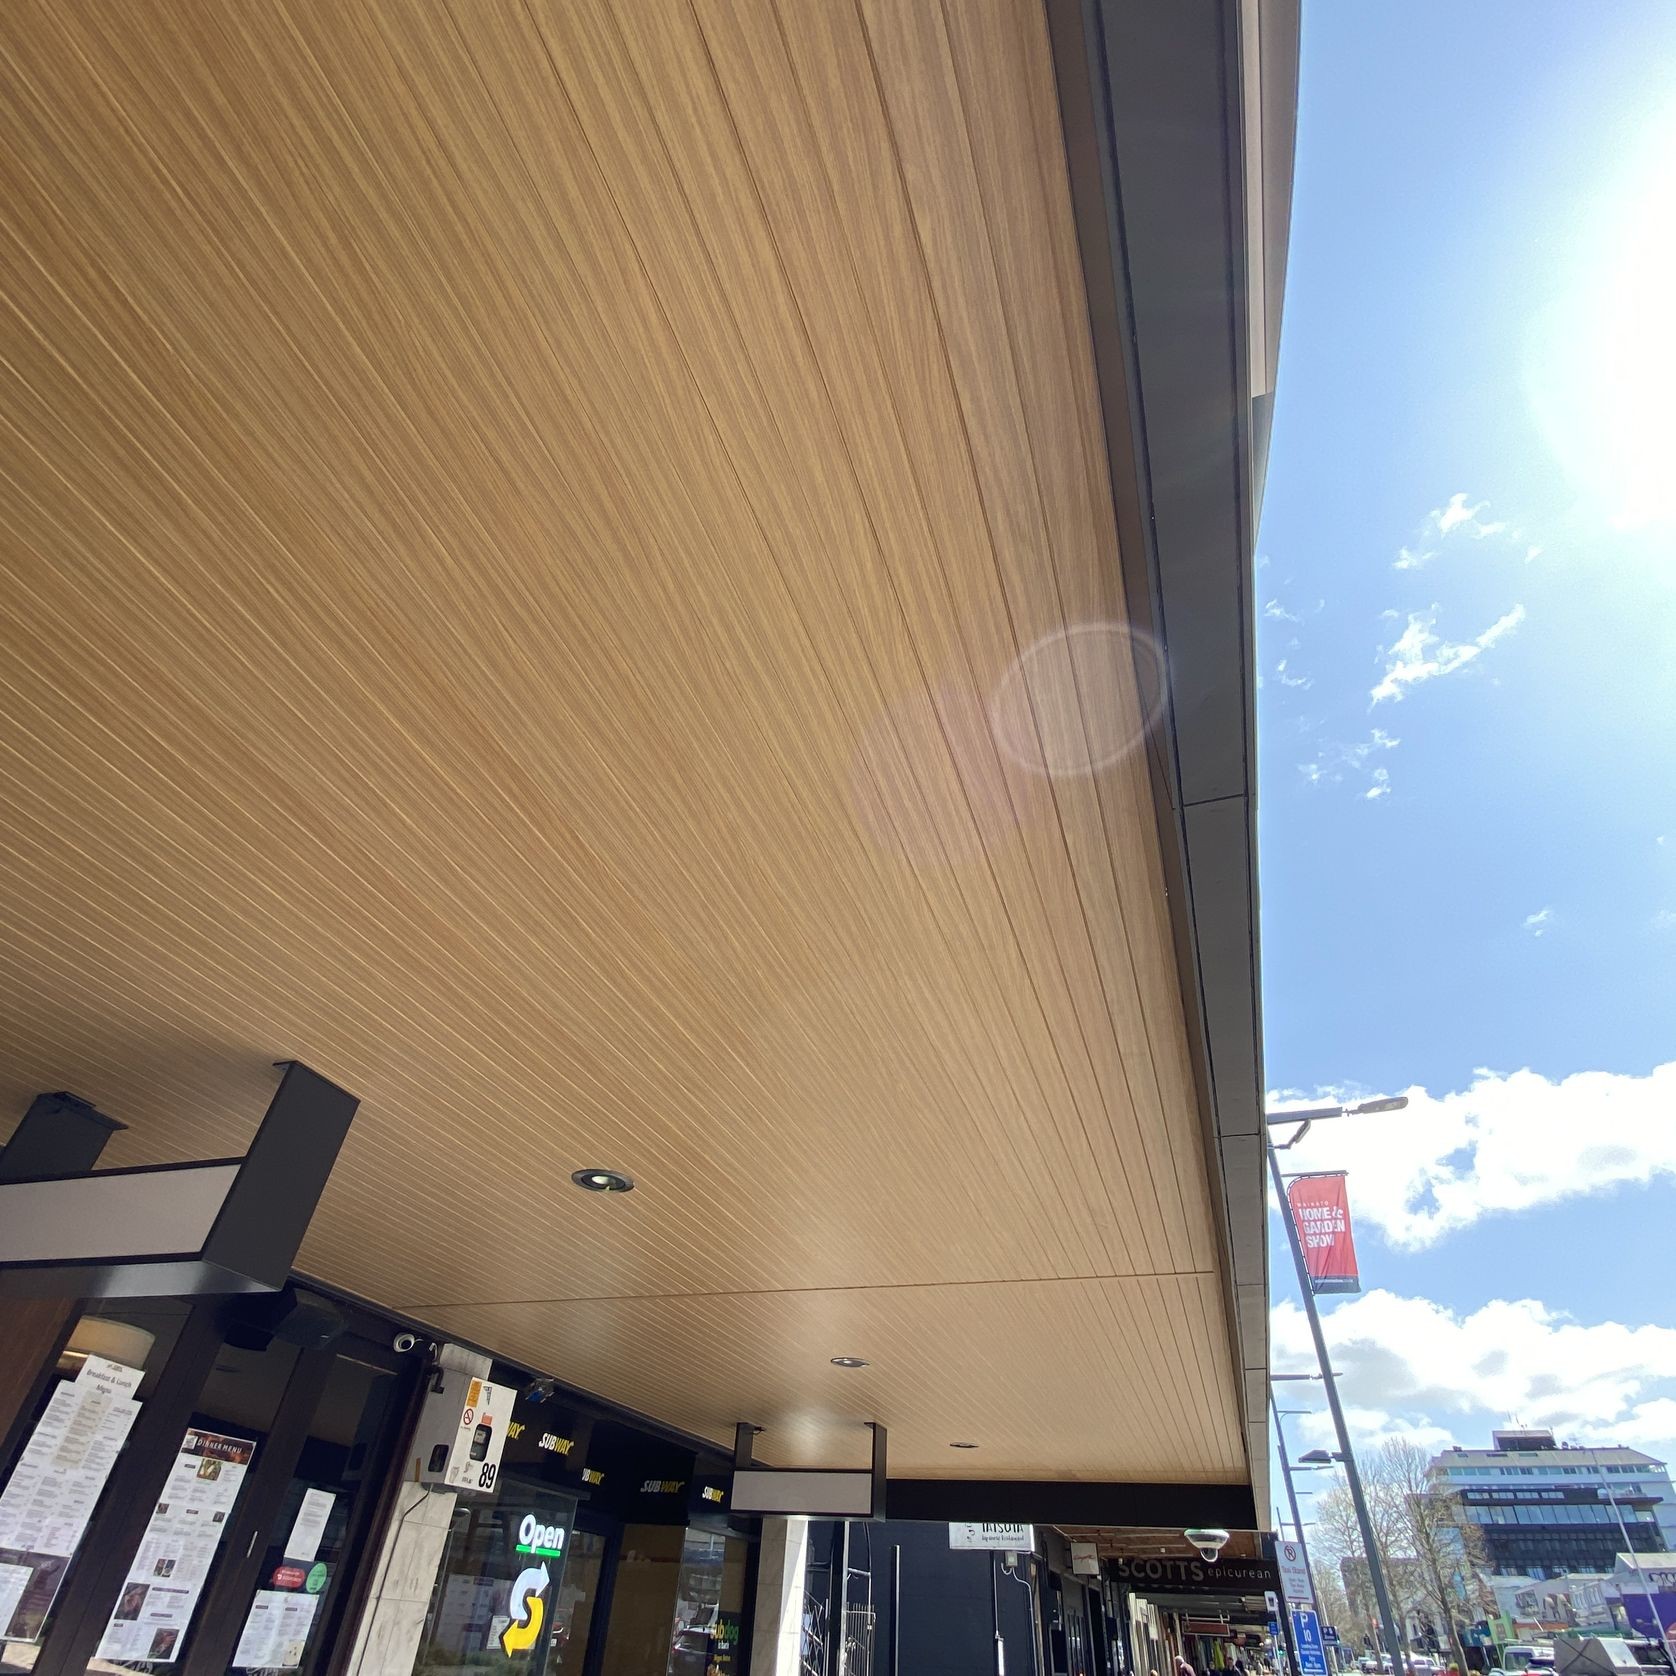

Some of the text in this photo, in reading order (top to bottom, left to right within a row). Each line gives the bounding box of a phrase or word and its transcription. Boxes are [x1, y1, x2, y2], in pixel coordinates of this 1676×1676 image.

[1299, 1207, 1332, 1221] HOME
[1303, 1219, 1346, 1234] GARDEN
[1305, 1234, 1335, 1248] SHOW
[197, 1440, 222, 1450] DINNER
[222, 1444, 242, 1454] MENU
[538, 1432, 574, 1456] SUBWAY
[479, 1462, 496, 1489] 89
[640, 1480, 685, 1493] SUBWAY
[519, 1514, 565, 1554] Open
[1118, 1558, 1272, 1582] SCOTTS epicurean
[1300, 1612, 1309, 1629] P
[1303, 1629, 1312, 1642] 10
